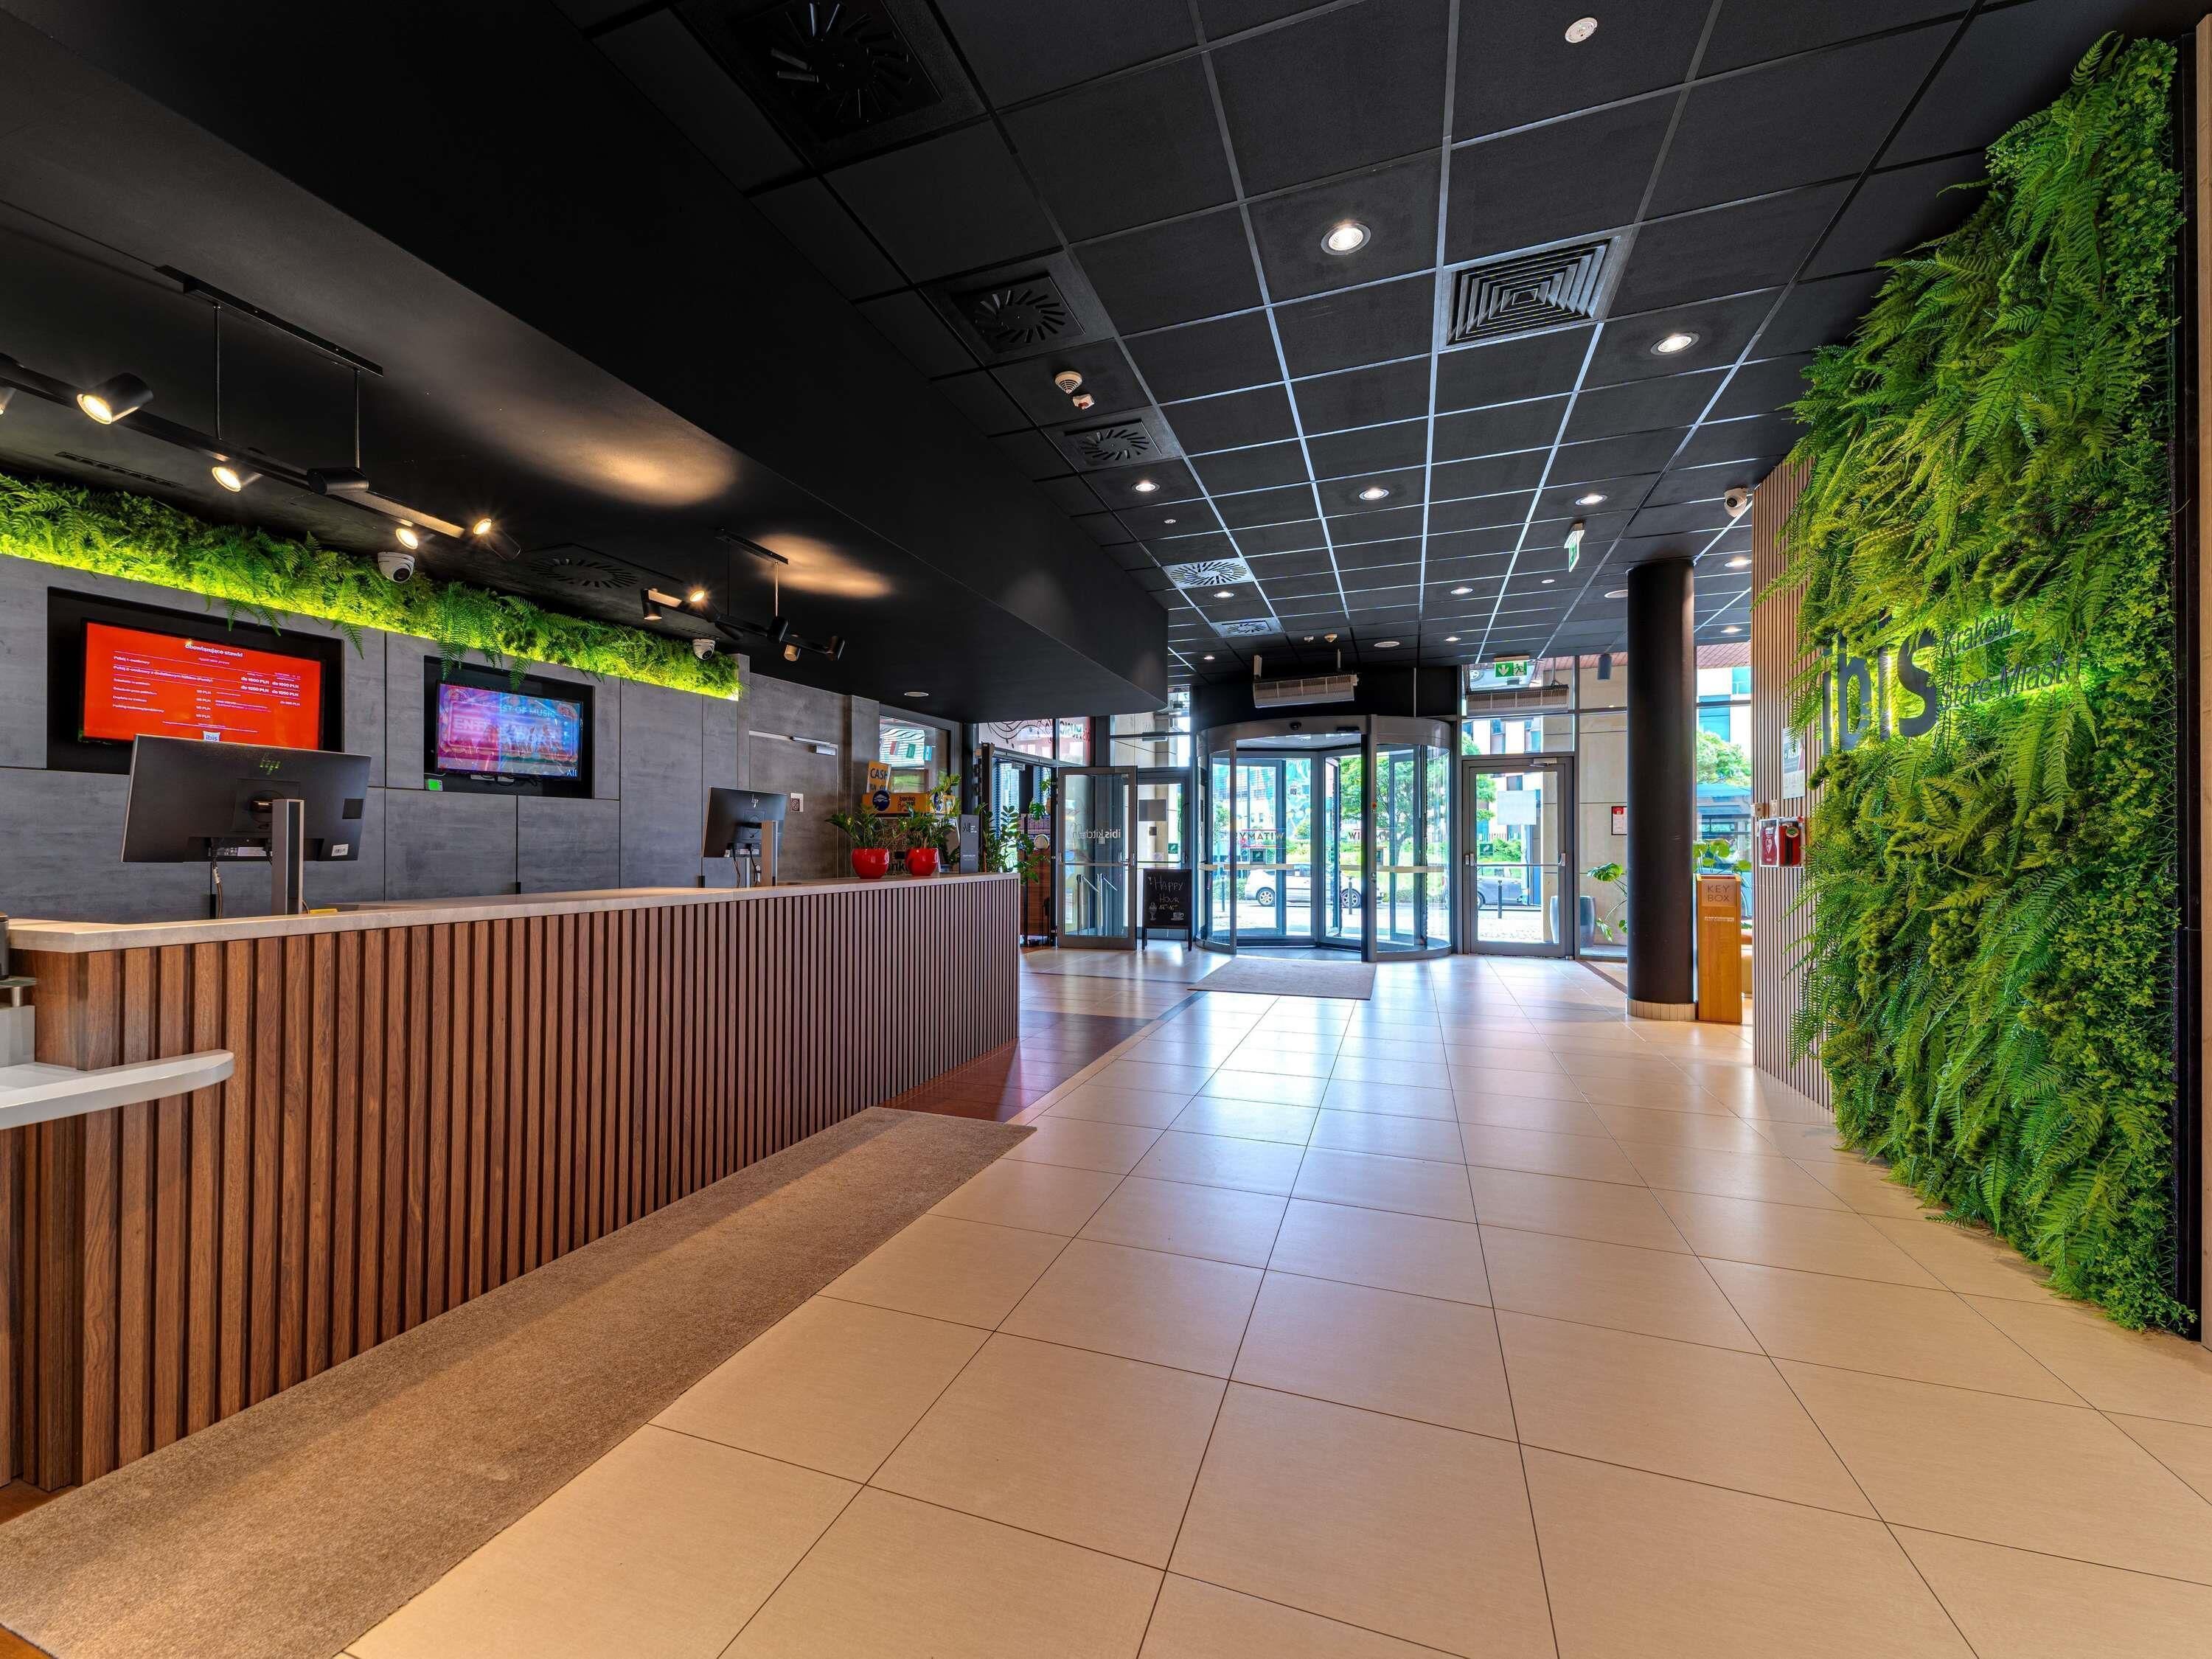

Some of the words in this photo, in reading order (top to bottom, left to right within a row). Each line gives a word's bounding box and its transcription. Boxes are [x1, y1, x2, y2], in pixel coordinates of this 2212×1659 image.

[1822, 609, 1937, 756] ibis
[206, 734, 218, 742] ibis
[870, 768, 888, 780] CASH
[1707, 885, 1730, 893] KEY
[1707, 894, 1730, 902] BOX
